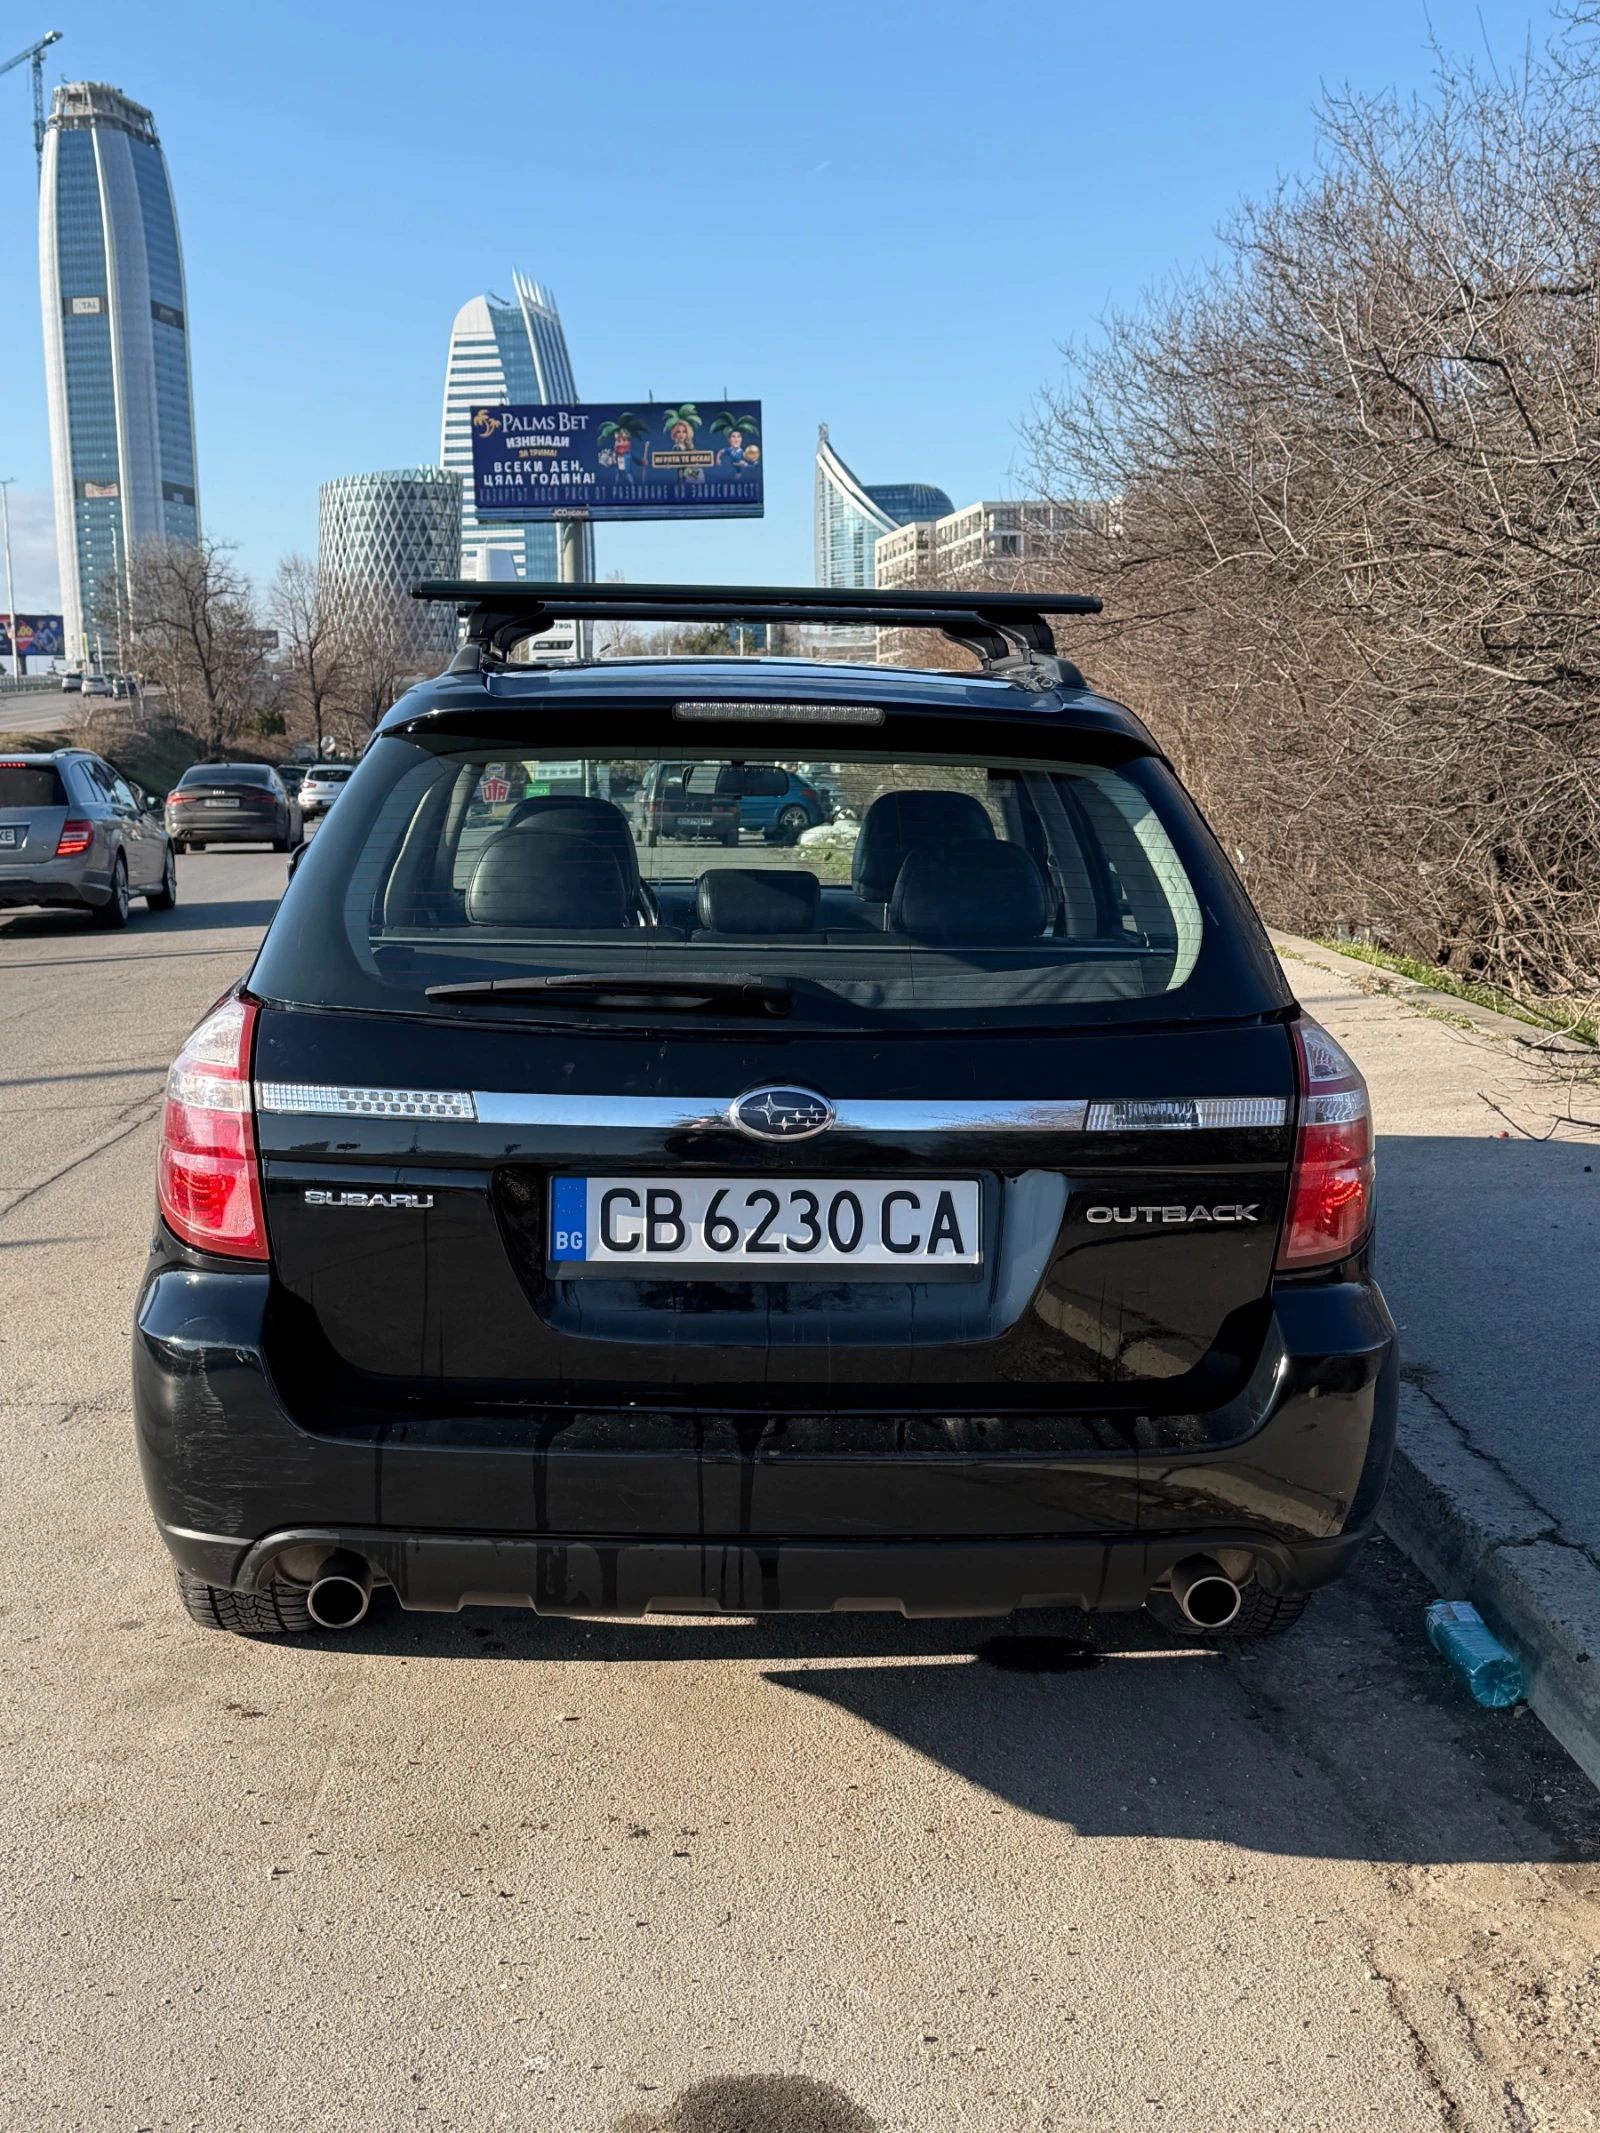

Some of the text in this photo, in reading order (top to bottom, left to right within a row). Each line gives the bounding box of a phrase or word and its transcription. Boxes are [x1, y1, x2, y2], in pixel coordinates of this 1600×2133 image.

[505, 435, 570, 449] ИЗНЕНАДИ
[518, 450, 528, 458] ЗА
[493, 461, 543, 473] ВСЕКИ
[483, 473, 596, 487] ЦЯЛА ГОДИНА!
[304, 1191, 434, 1208] SUBARU
[1086, 1203, 1260, 1223] OUTBACK
[600, 1187, 966, 1255] CB 6230 CA
[555, 1231, 583, 1251] BG
